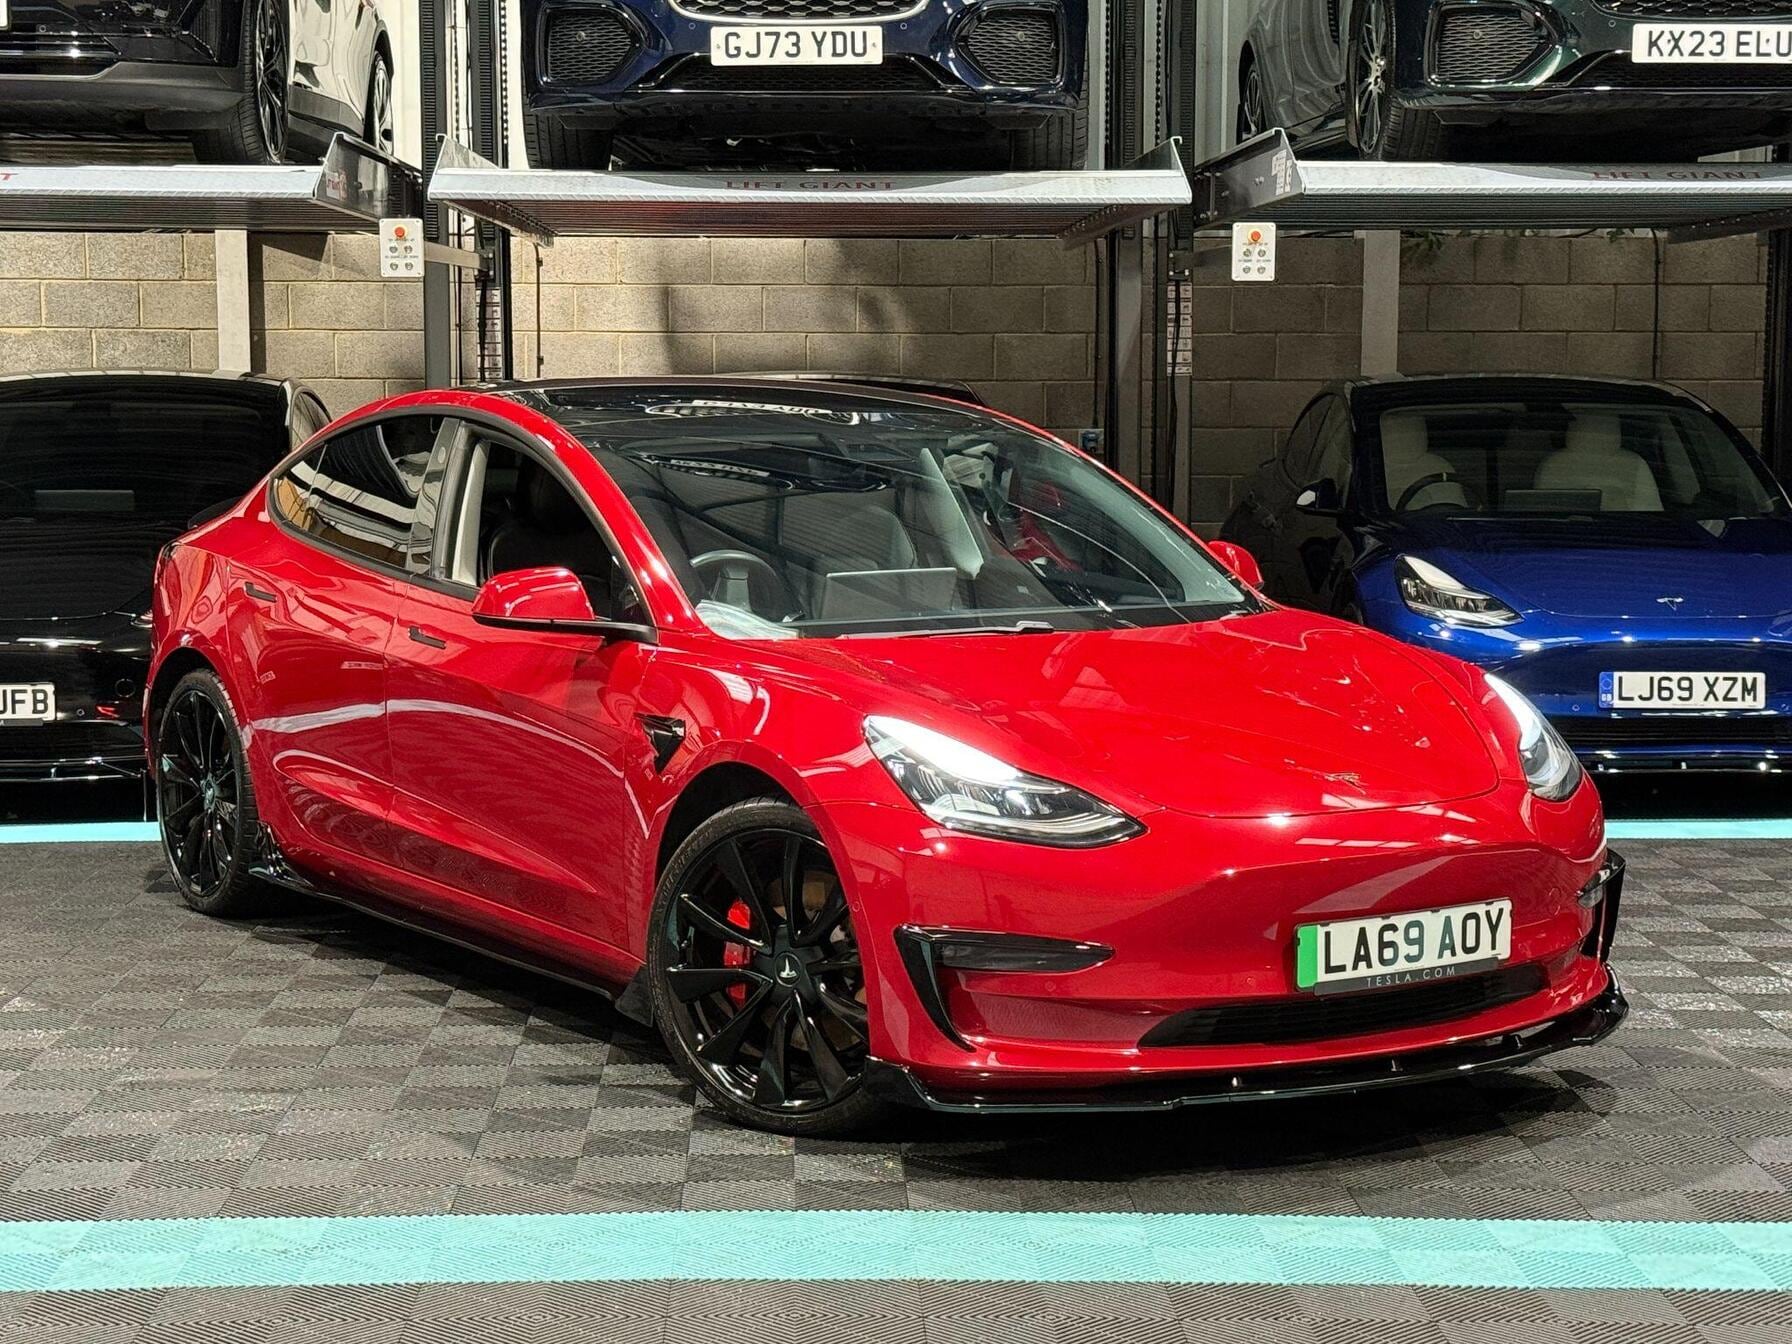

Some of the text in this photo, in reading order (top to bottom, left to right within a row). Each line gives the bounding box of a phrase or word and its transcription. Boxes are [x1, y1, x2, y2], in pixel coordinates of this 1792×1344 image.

[724, 30, 868, 59] GJ73 YDU
[1647, 30, 1792, 57] KX23 ELU
[799, 181, 897, 189] GIANT
[1666, 171, 1763, 179] GIANT
[1618, 676, 1758, 702] LJ69 XZM
[1324, 907, 1504, 974] LA69 AOY
[1366, 966, 1456, 988] TESLA.COM
